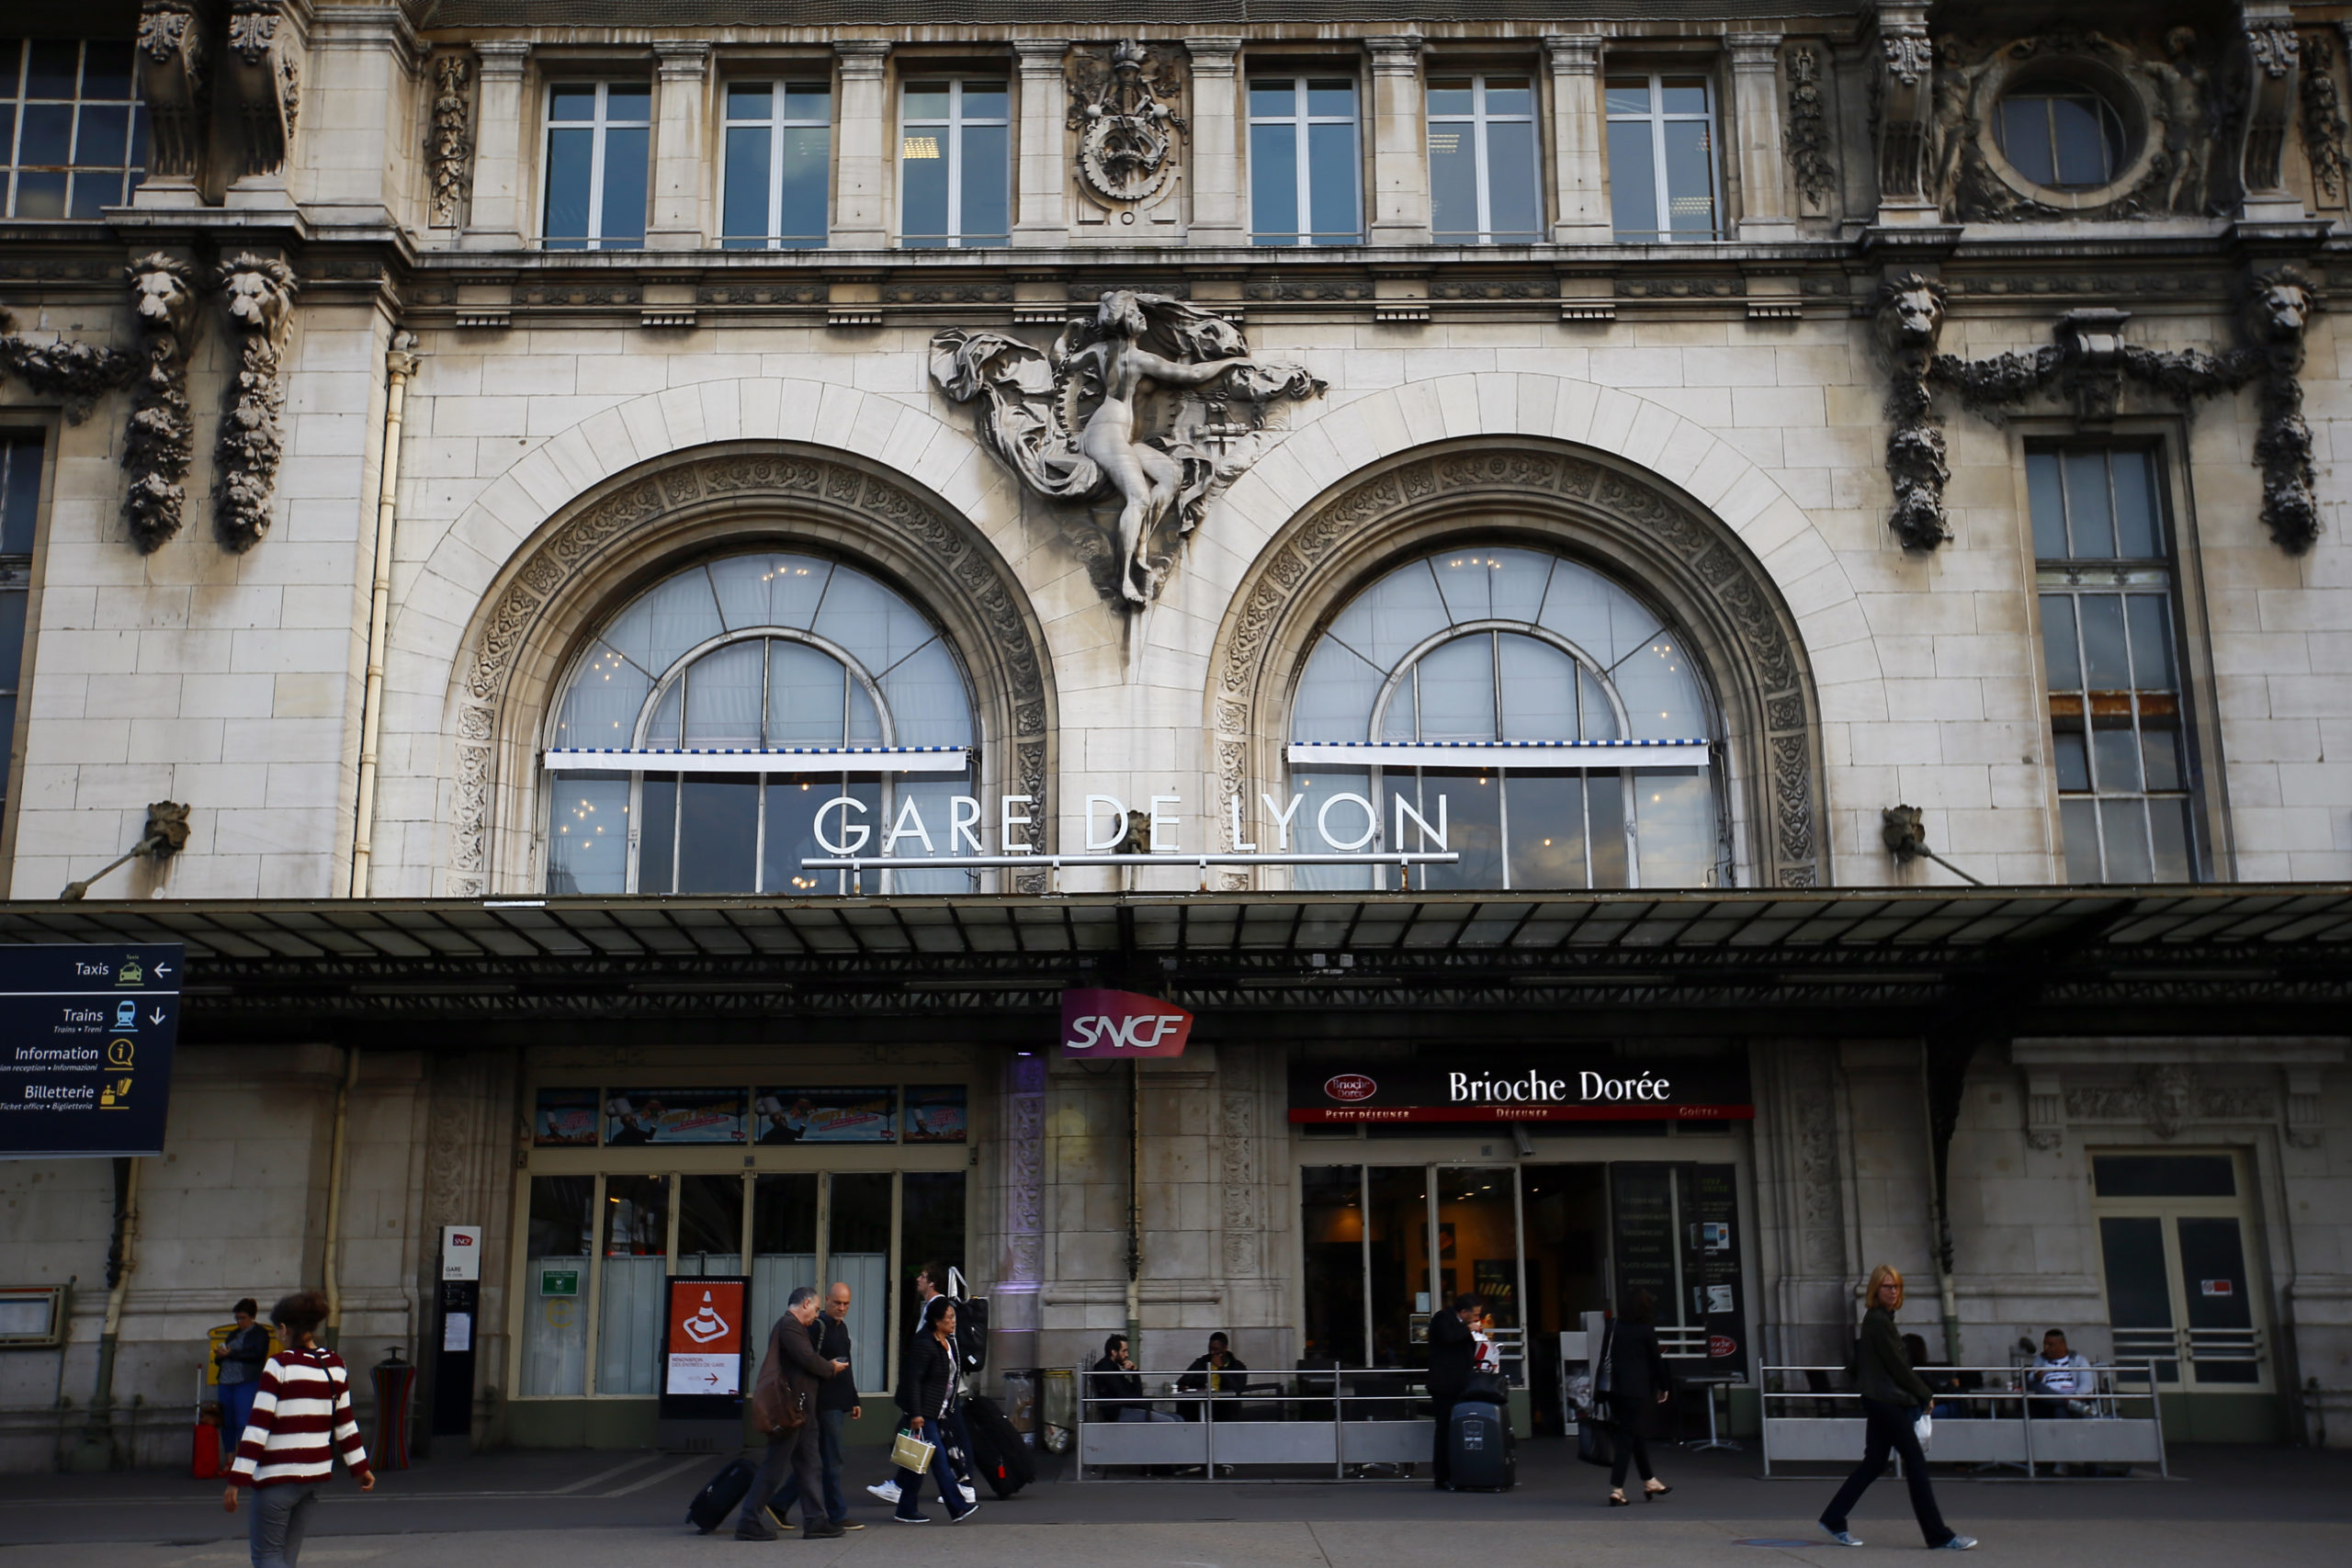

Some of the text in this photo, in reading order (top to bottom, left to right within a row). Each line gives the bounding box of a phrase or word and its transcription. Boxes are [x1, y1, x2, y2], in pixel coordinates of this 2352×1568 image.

[814, 793, 1448, 855] GARE DE LYON
[75, 963, 109, 976] Taxis
[63, 1009, 104, 1021] Trains
[84, 1025, 103, 1033] Treni
[1066, 1015, 1184, 1049] SNCF
[16, 1046, 98, 1060] Information
[12, 1064, 46, 1073] reception
[1332, 1078, 1371, 1089] Brioche
[1448, 1068, 1671, 1101] Brioche Dorée
[25, 1085, 95, 1099] Billetterie
[51, 1102, 93, 1111] Biglietteria
